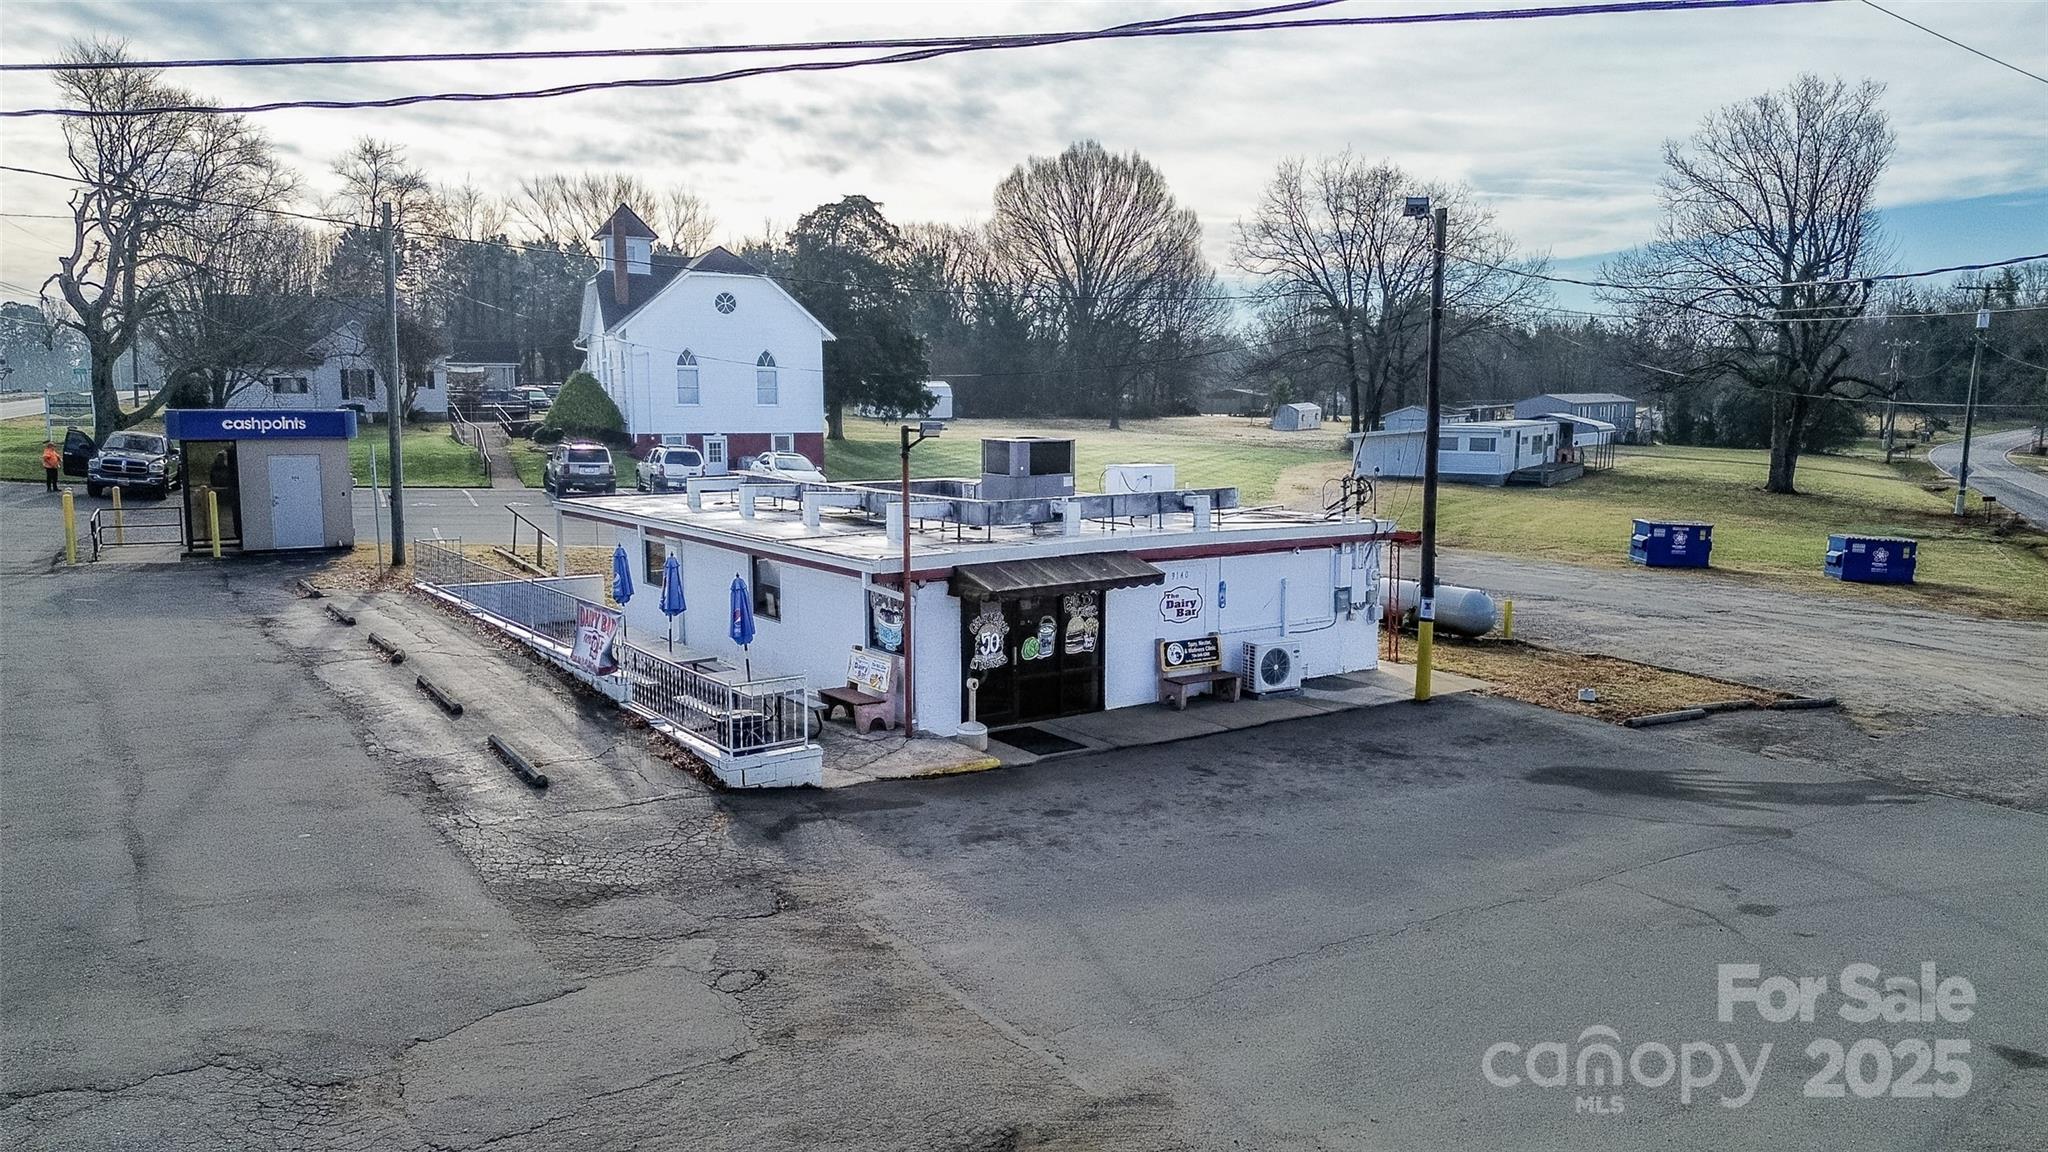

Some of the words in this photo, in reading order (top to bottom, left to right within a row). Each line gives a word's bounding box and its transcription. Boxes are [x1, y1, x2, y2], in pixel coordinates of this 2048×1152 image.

[222, 416, 306, 433] cashpoints
[1171, 571, 1189, 580] 9140
[1166, 599, 1197, 609] Dairy
[1176, 608, 1197, 617] Bar
[980, 632, 1000, 656] 50
[854, 662, 868, 673] Dairy
